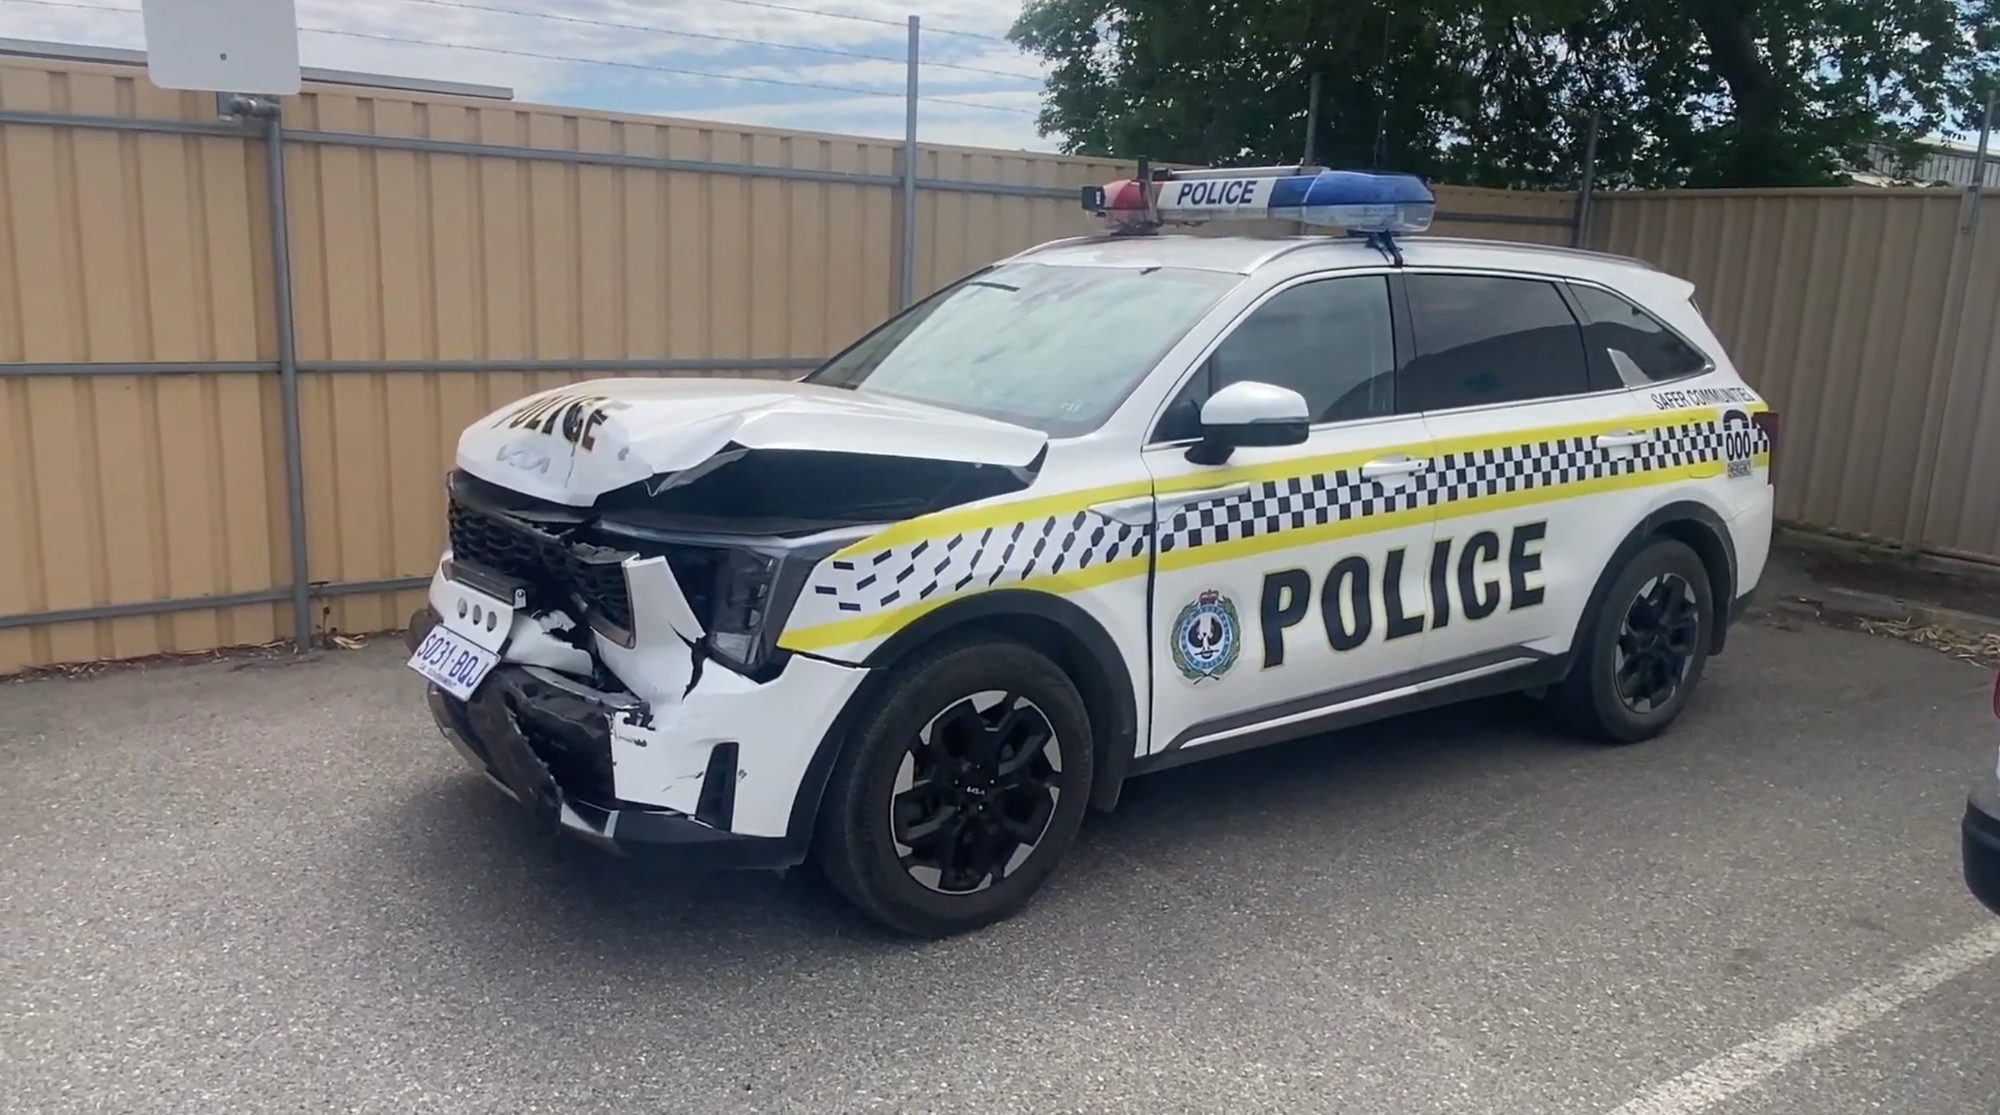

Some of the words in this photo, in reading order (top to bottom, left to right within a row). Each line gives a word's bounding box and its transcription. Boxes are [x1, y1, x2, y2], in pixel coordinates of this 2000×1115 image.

[1177, 180, 1258, 206] POLICE
[1651, 390, 1689, 410] SAFER
[1725, 430, 1751, 461] 000
[1260, 519, 1548, 670] POLICE
